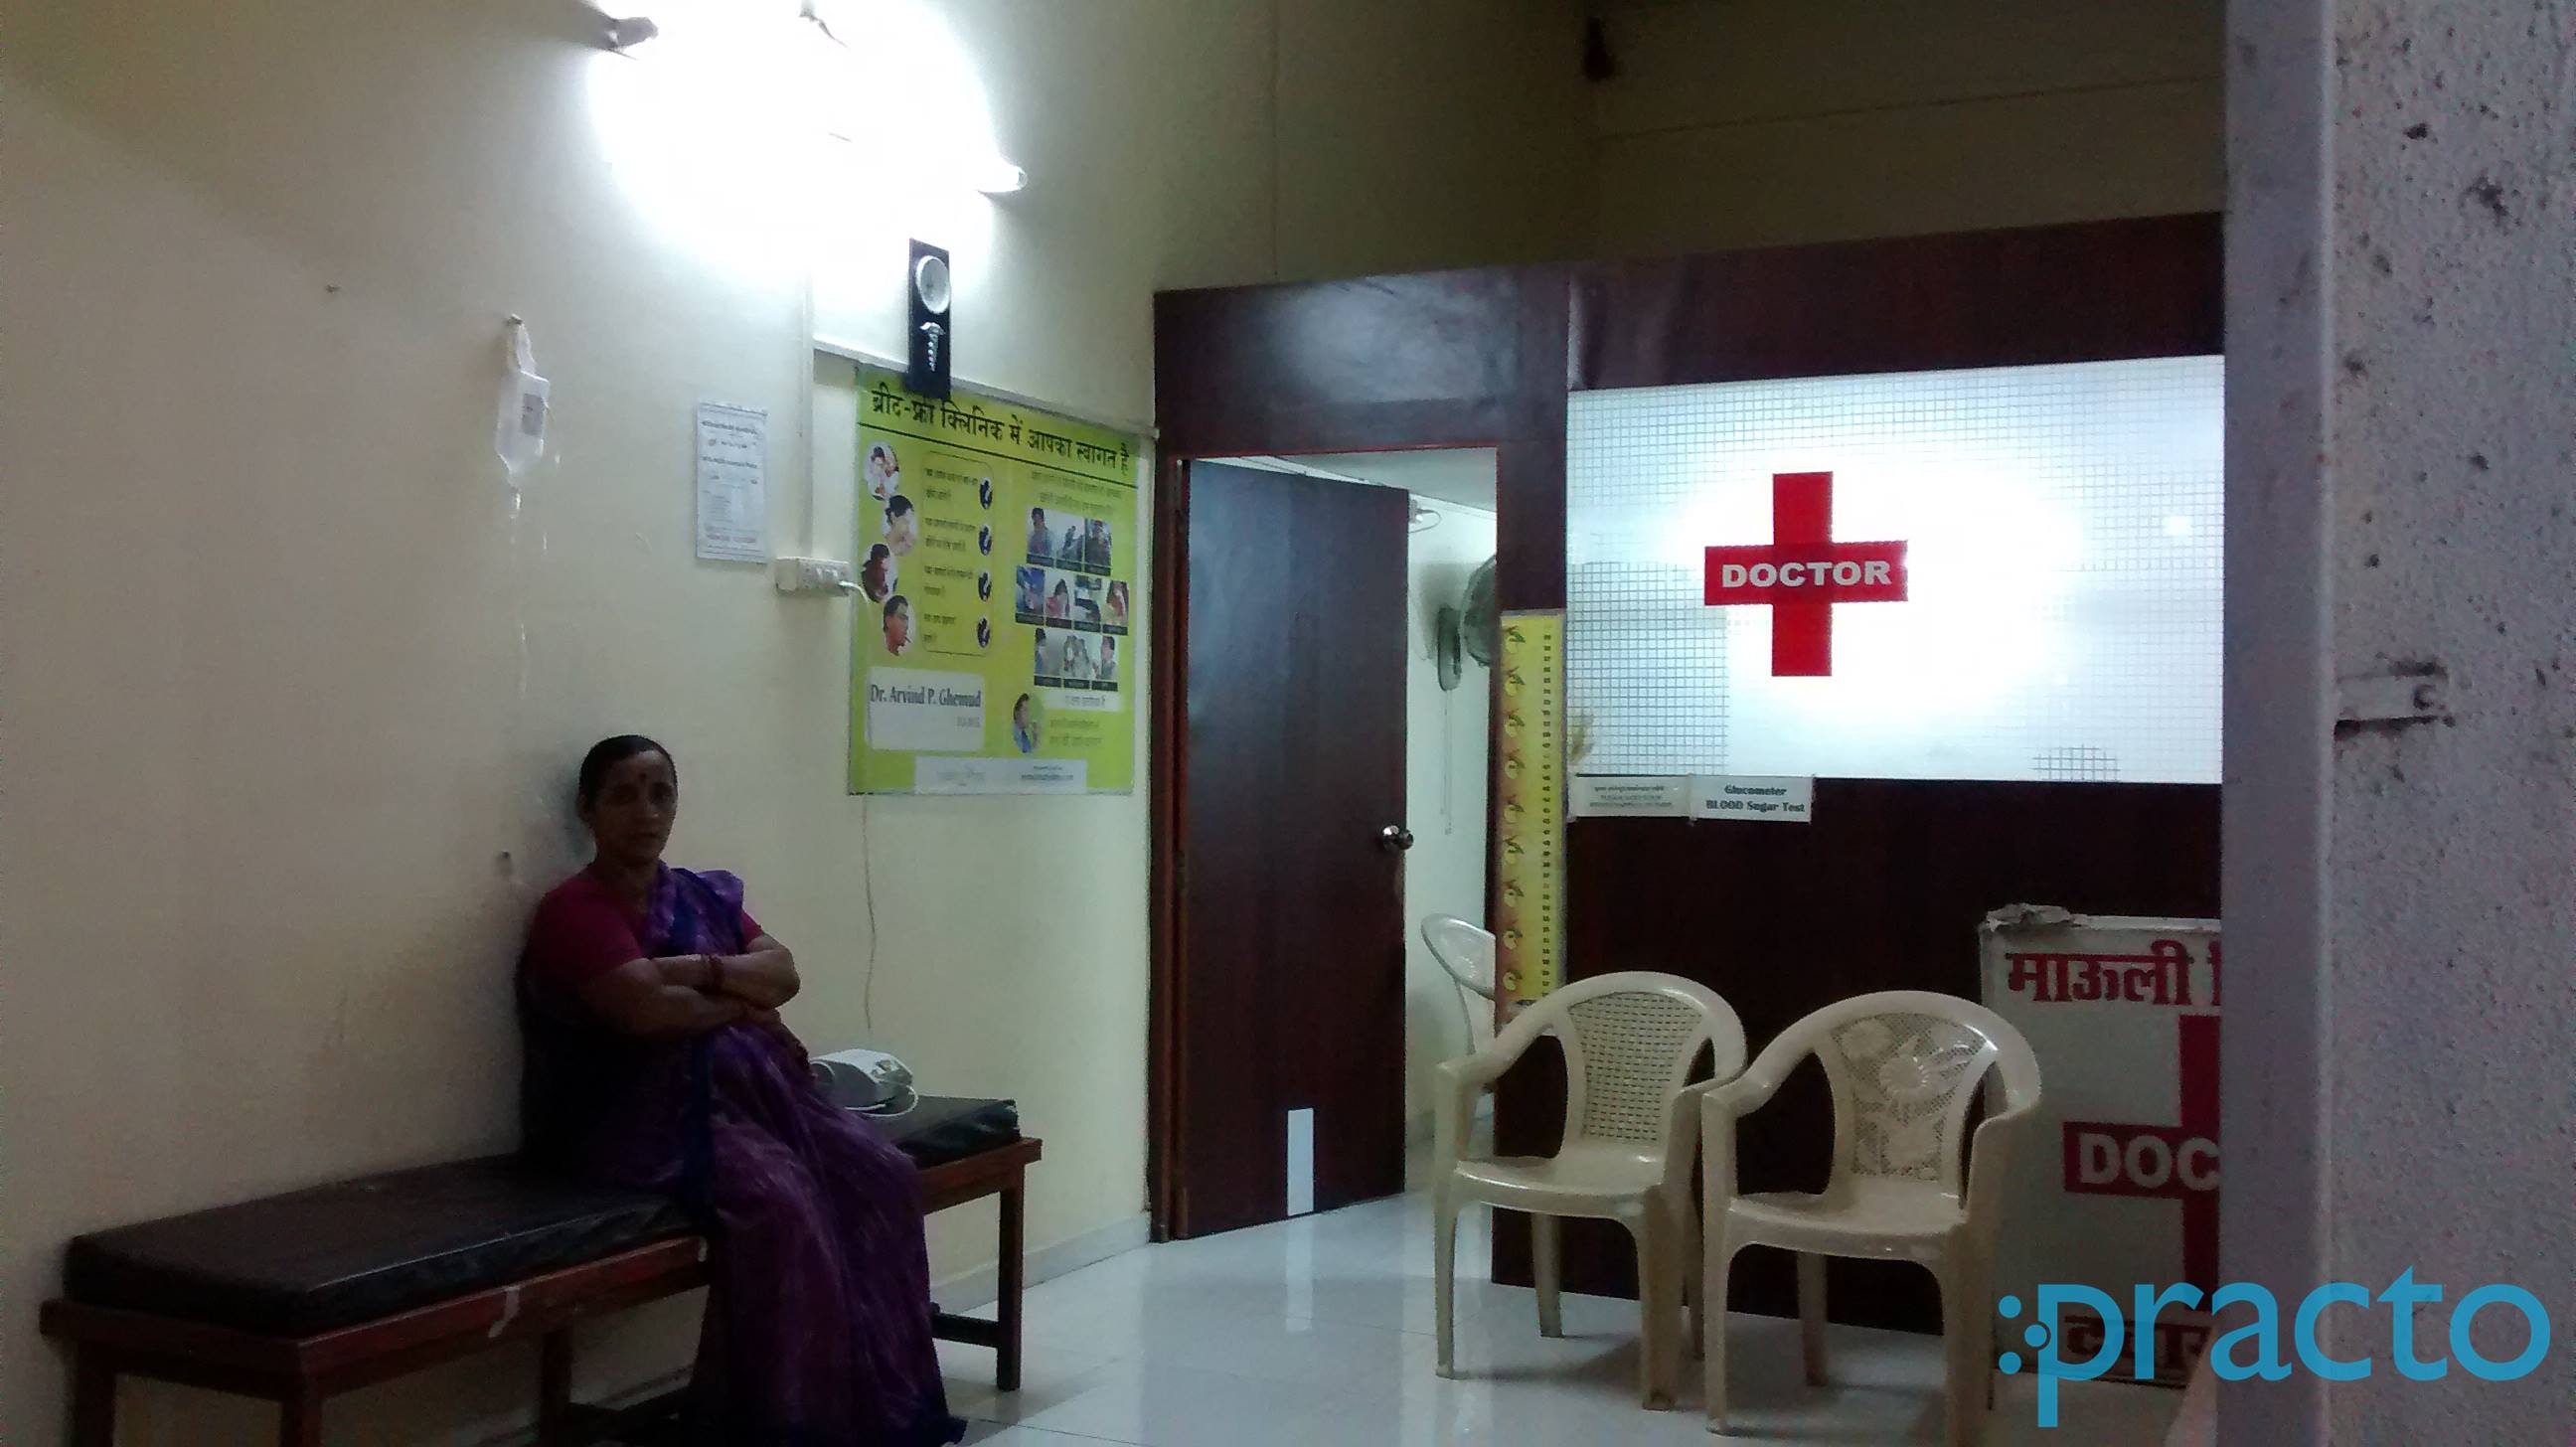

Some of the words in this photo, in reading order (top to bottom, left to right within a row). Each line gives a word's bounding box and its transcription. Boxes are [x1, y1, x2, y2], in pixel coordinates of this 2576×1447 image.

[940, 399, 1005, 441] क्लिनिक
[1009, 414, 1024, 445] में
[1027, 429, 1072, 458] आपका
[1076, 441, 1118, 469] स्वागत
[1120, 442, 1130, 476] है
[1721, 561, 1892, 588] DOCTOR
[870, 684, 886, 703] Dr.
[1724, 784, 1787, 796] Glucometer
[1705, 799, 1744, 810] BLOOD
[1746, 801, 1779, 813] Sugar
[1782, 802, 1806, 813] Test
[2006, 939, 2194, 1006] माऊली
